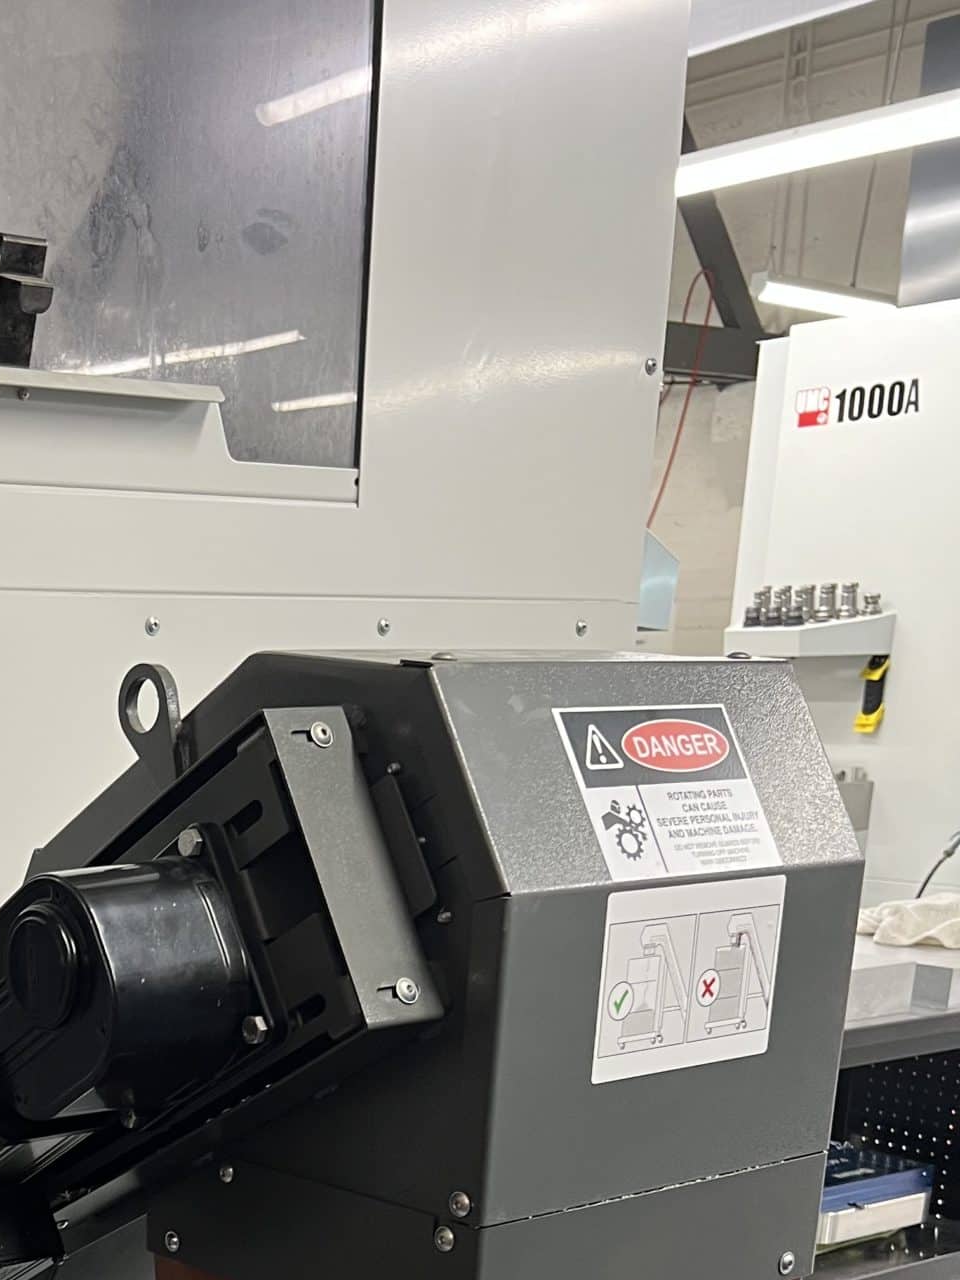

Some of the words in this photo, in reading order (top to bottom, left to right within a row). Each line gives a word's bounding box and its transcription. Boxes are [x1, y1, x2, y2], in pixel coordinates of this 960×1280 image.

[835, 378, 920, 423] 1000A
[632, 733, 722, 759] DANGER
[666, 790, 706, 801] ROTATING
[707, 788, 733, 798] PARTS
[681, 802, 700, 813] CAN
[700, 800, 728, 811] CAUSE
[656, 816, 689, 827] SEVERE
[689, 812, 732, 825] PERSONAL
[732, 810, 759, 821] INJURY
[667, 828, 685, 839] AND
[685, 825, 722, 837] MACHINE
